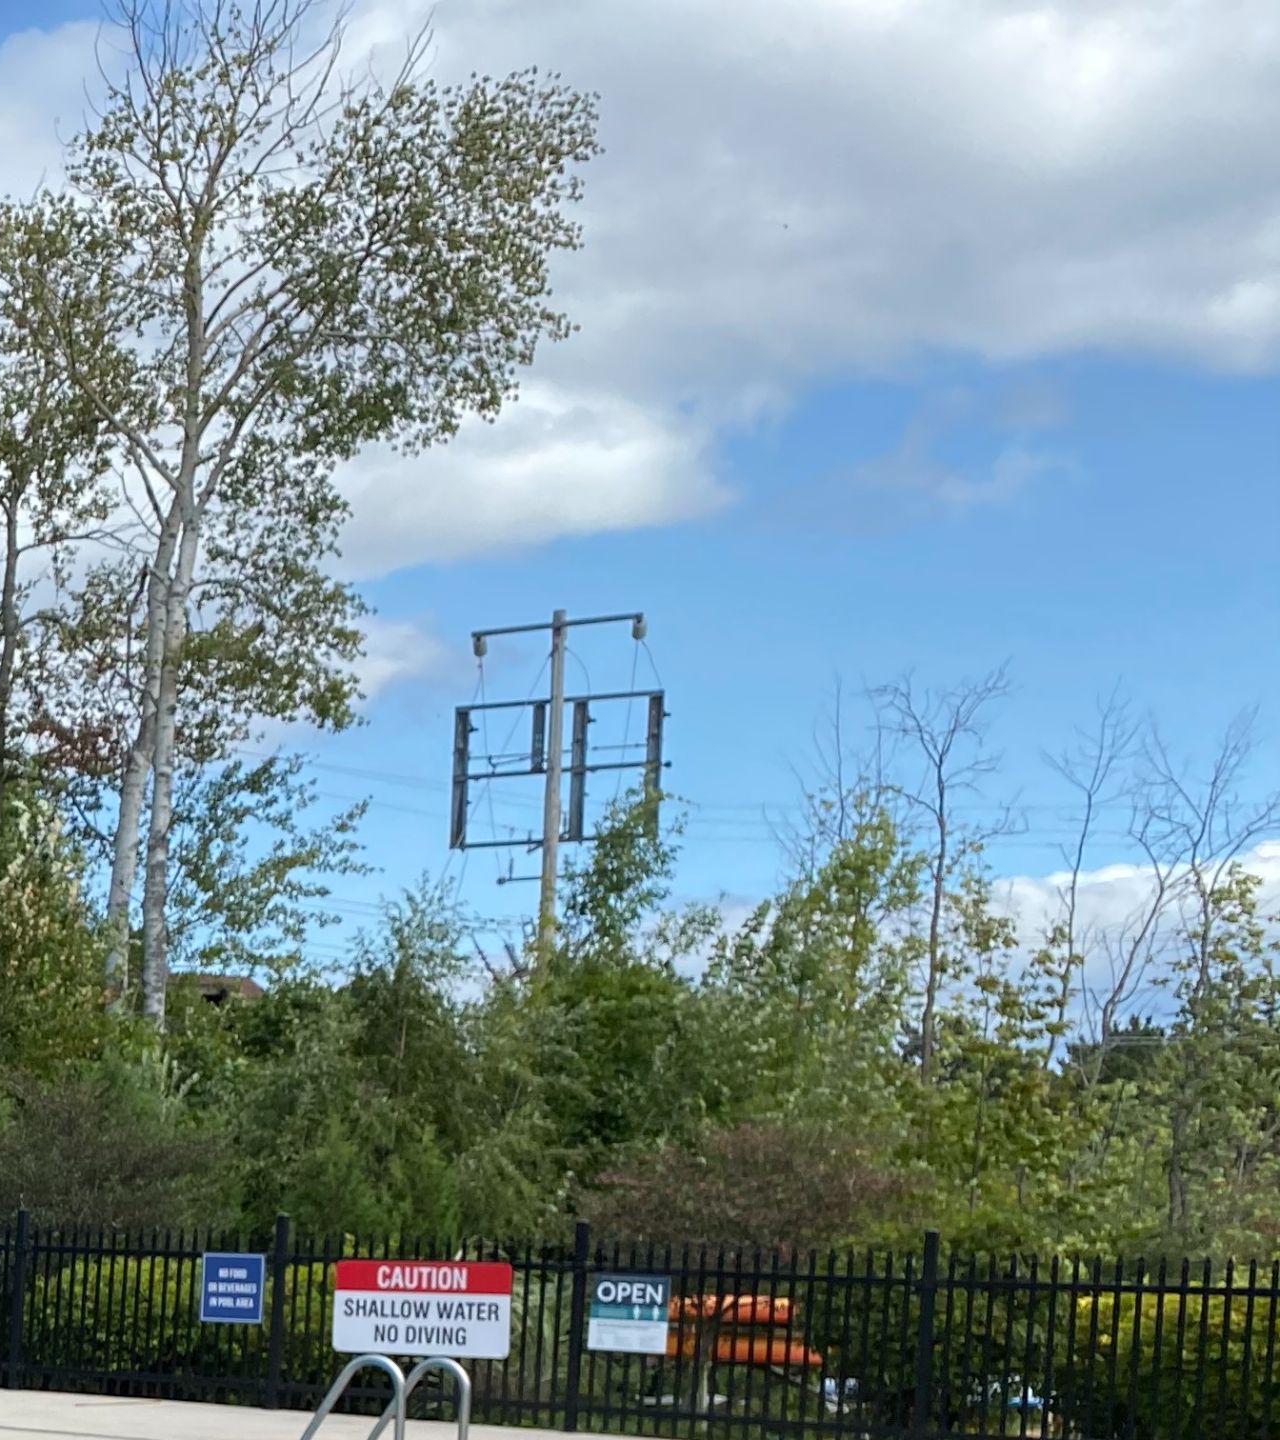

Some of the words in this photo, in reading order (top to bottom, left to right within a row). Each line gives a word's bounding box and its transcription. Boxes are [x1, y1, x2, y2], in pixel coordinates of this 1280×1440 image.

[377, 1265, 468, 1290] CAUTION
[597, 1281, 664, 1305] OPEN
[344, 1298, 430, 1320] SHALLOW
[436, 1301, 500, 1322] WATER
[374, 1324, 398, 1343] NO
[405, 1325, 467, 1346] DIVING
